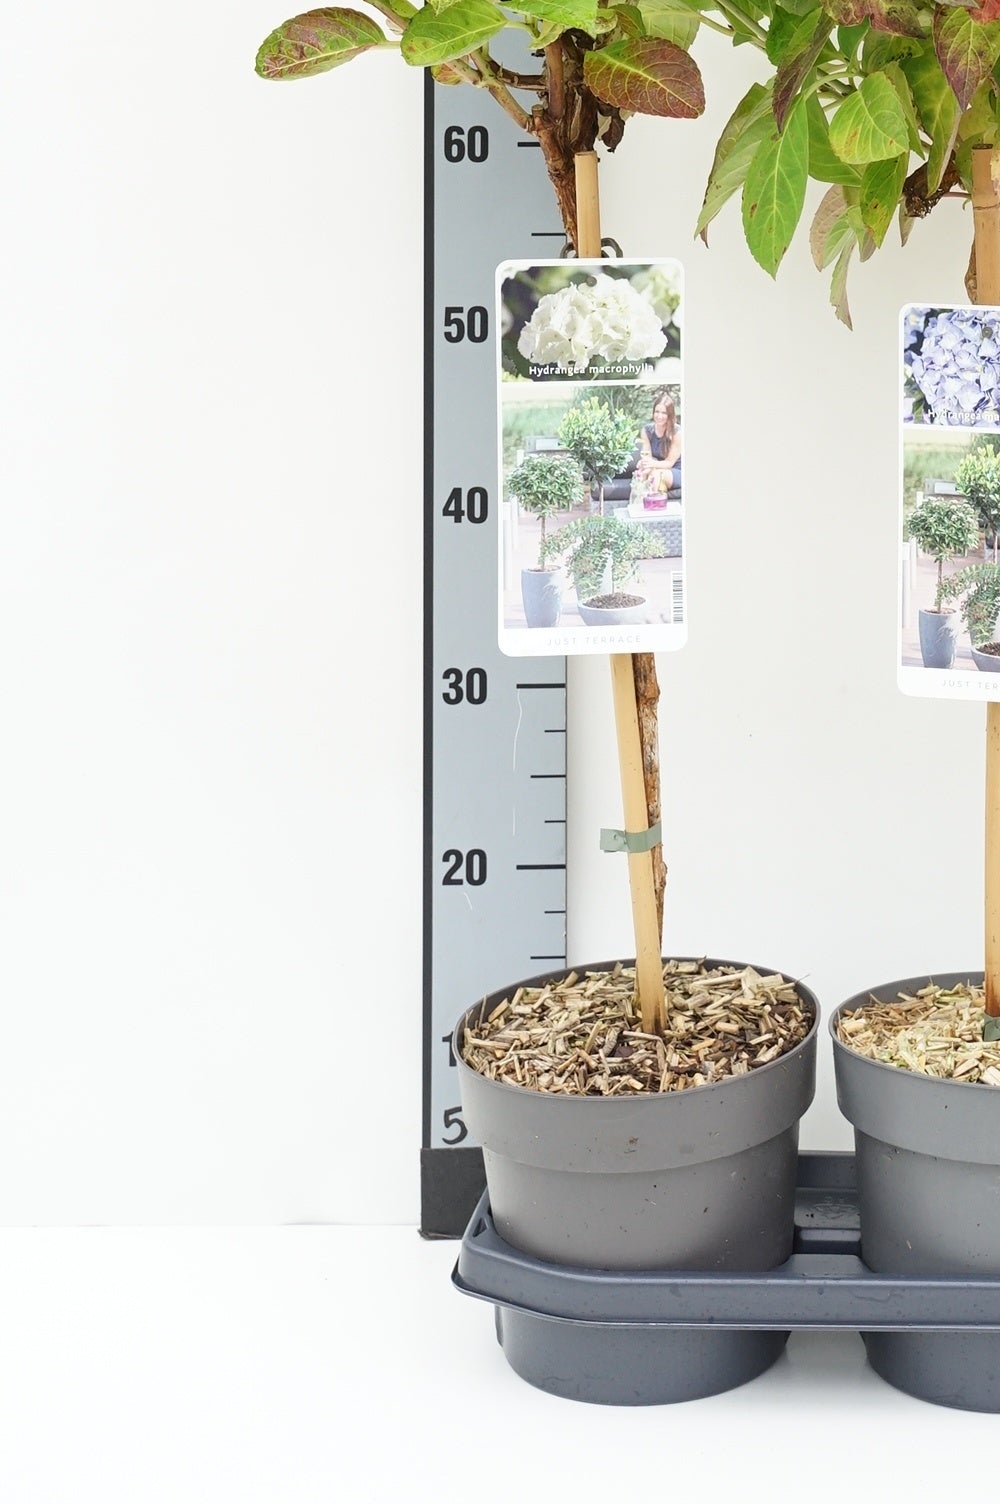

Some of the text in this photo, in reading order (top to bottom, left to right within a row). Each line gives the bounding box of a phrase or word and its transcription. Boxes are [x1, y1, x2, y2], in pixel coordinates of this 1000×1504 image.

[443, 125, 489, 163] 60
[443, 306, 489, 344] 50
[529, 362, 654, 377] Hydrangea macrophylla
[442, 486, 489, 524] 40
[547, 634, 641, 647] JUST TERRACE
[442, 667, 488, 705] 30
[941, 680, 970, 688] JUST
[442, 848, 488, 886] 20
[442, 1106, 468, 1145] 5
